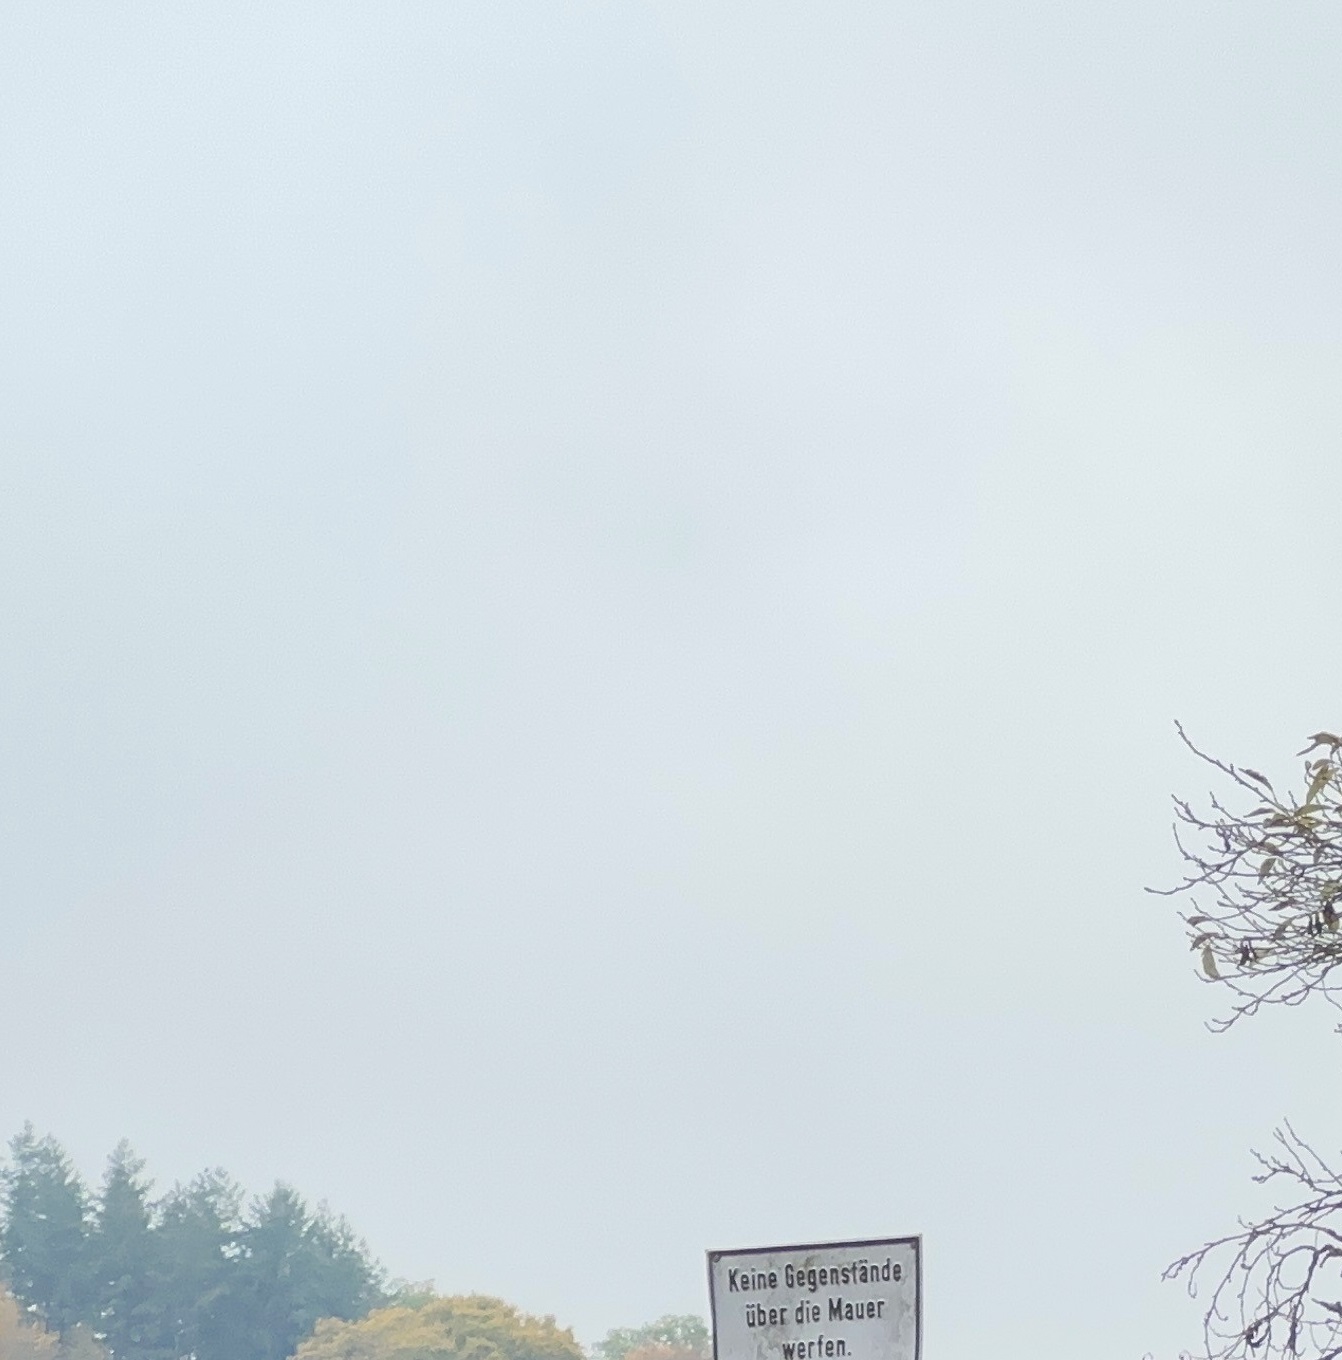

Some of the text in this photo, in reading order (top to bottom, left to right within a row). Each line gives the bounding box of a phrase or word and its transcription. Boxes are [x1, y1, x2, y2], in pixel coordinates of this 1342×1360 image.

[728, 1258, 902, 1293] Keine Gegenstände
[745, 1297, 885, 1328] über die Mauer
[782, 1334, 852, 1360] werfen.
